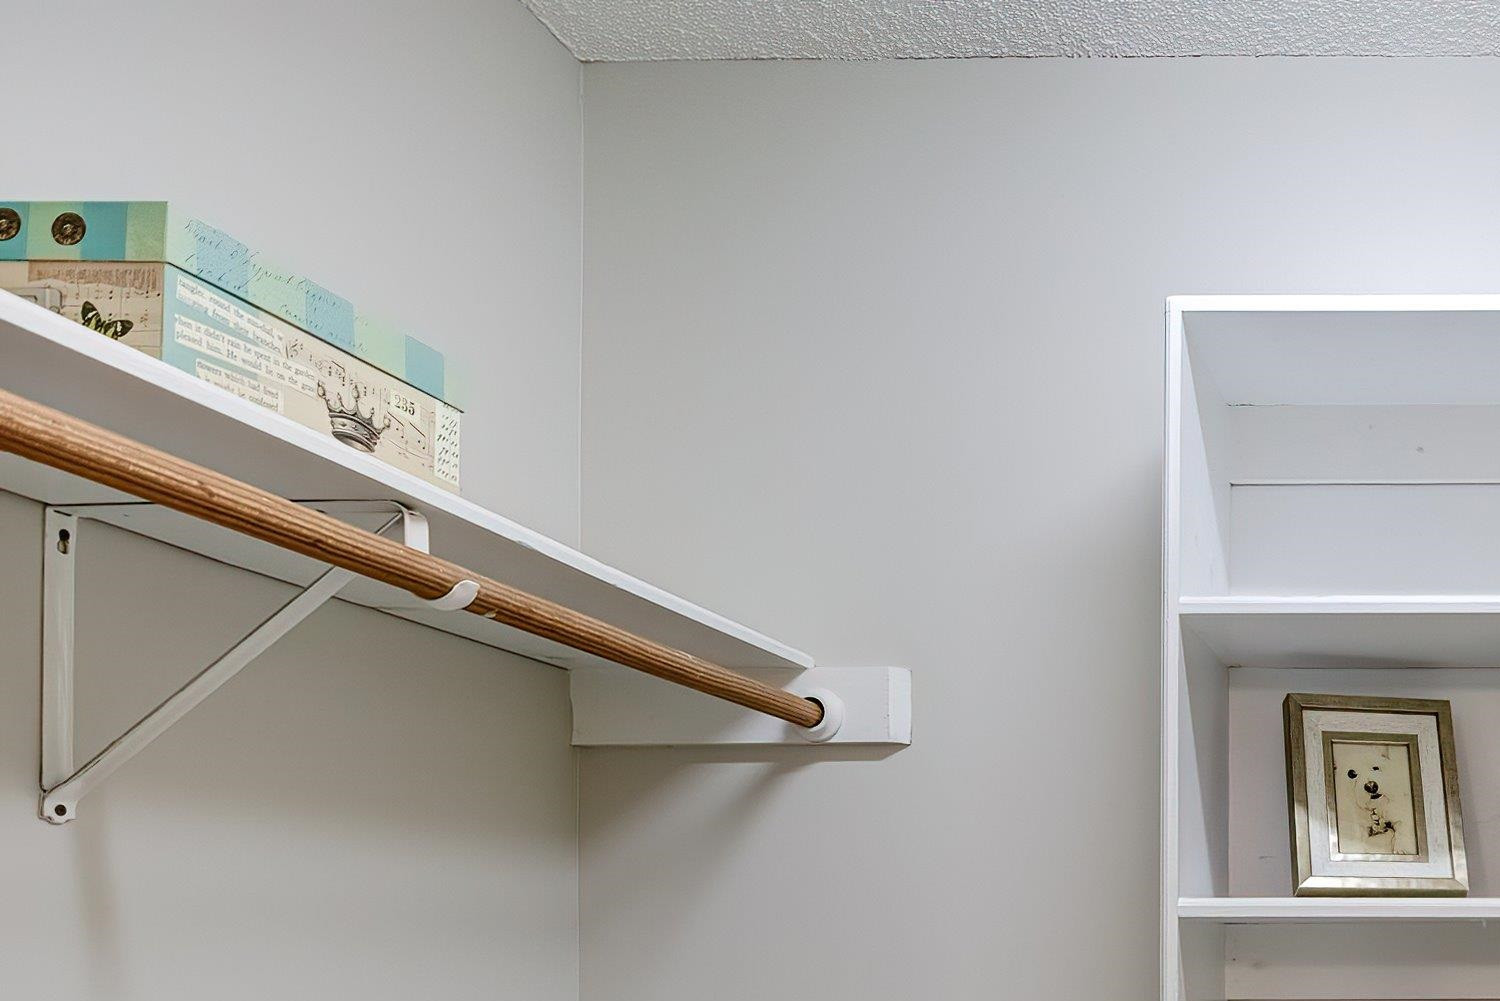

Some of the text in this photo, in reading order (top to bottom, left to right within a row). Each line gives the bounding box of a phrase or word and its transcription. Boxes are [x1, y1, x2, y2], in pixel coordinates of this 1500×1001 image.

[176, 329, 203, 347] pleased
[226, 347, 237, 361] He
[240, 356, 262, 372] would
[287, 375, 298, 387] the
[204, 328, 225, 344] didn't
[227, 338, 241, 351] rain
[243, 343, 252, 355] he
[282, 360, 293, 372] the
[394, 394, 415, 416] 235
